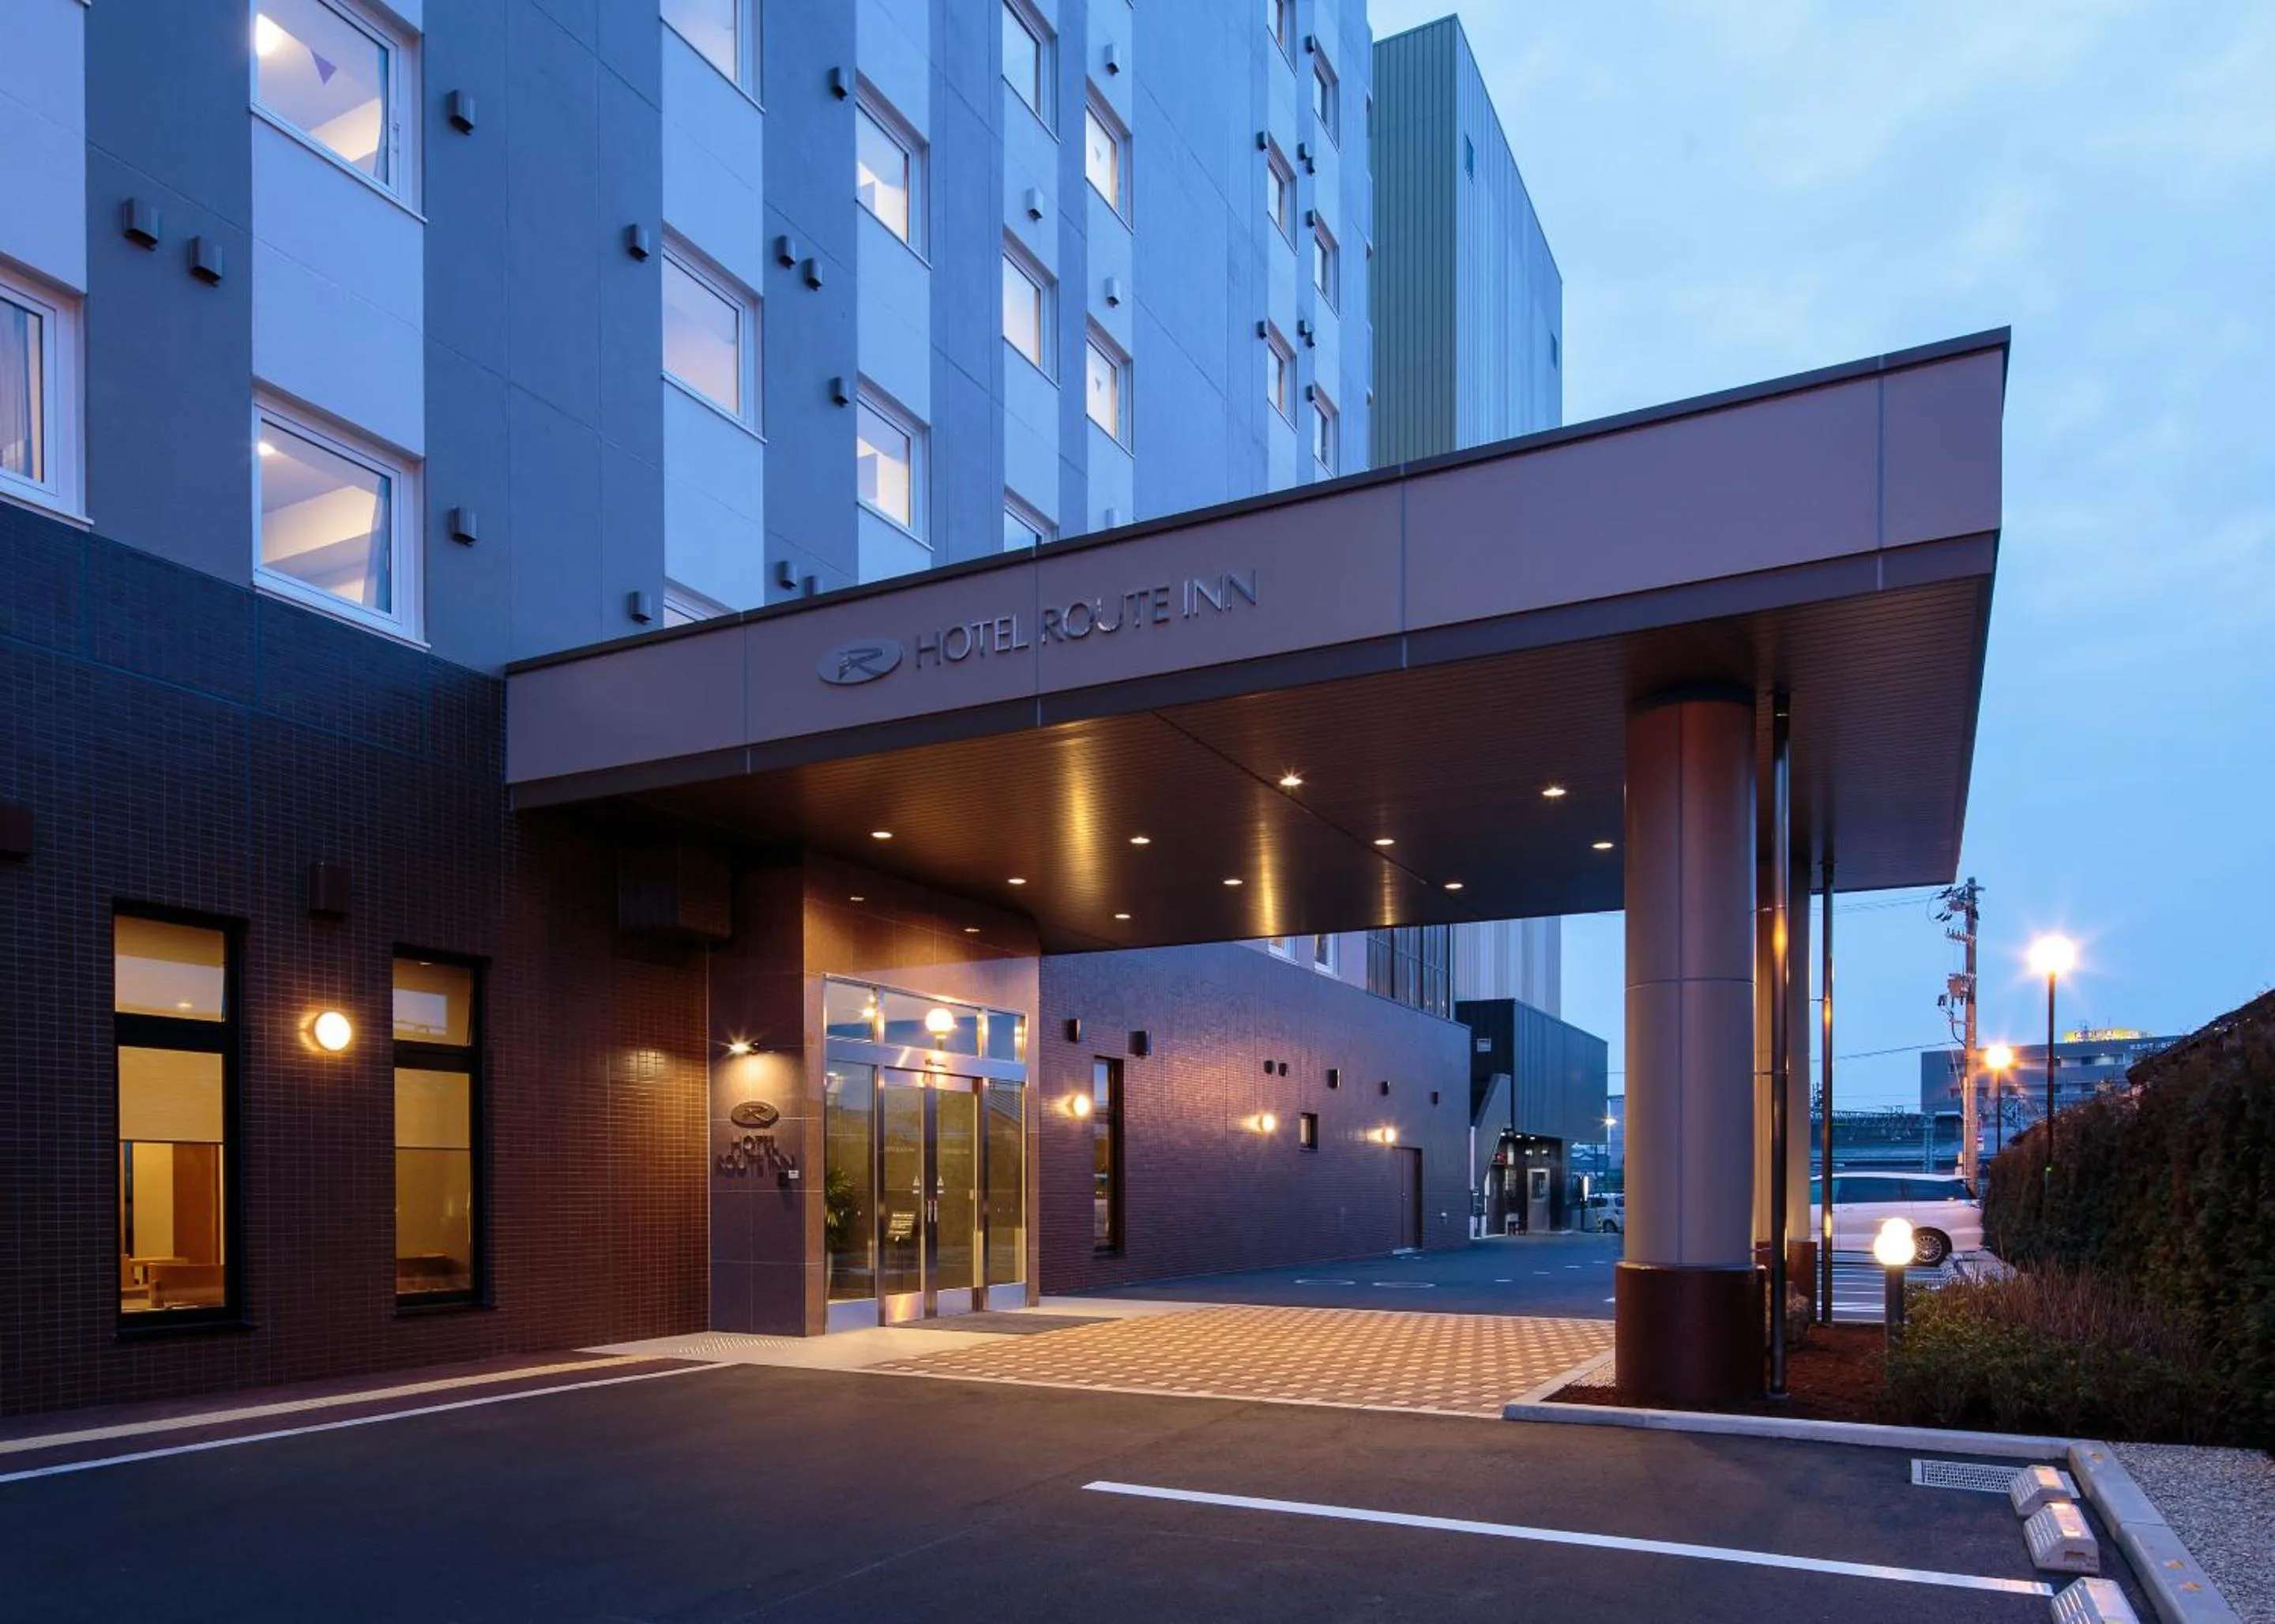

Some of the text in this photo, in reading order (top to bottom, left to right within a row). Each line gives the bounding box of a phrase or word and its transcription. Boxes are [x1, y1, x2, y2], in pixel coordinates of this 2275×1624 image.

[916, 613, 1029, 669] HOTEL
[1040, 587, 1170, 645] ROUTE
[1183, 568, 1258, 619] INN
